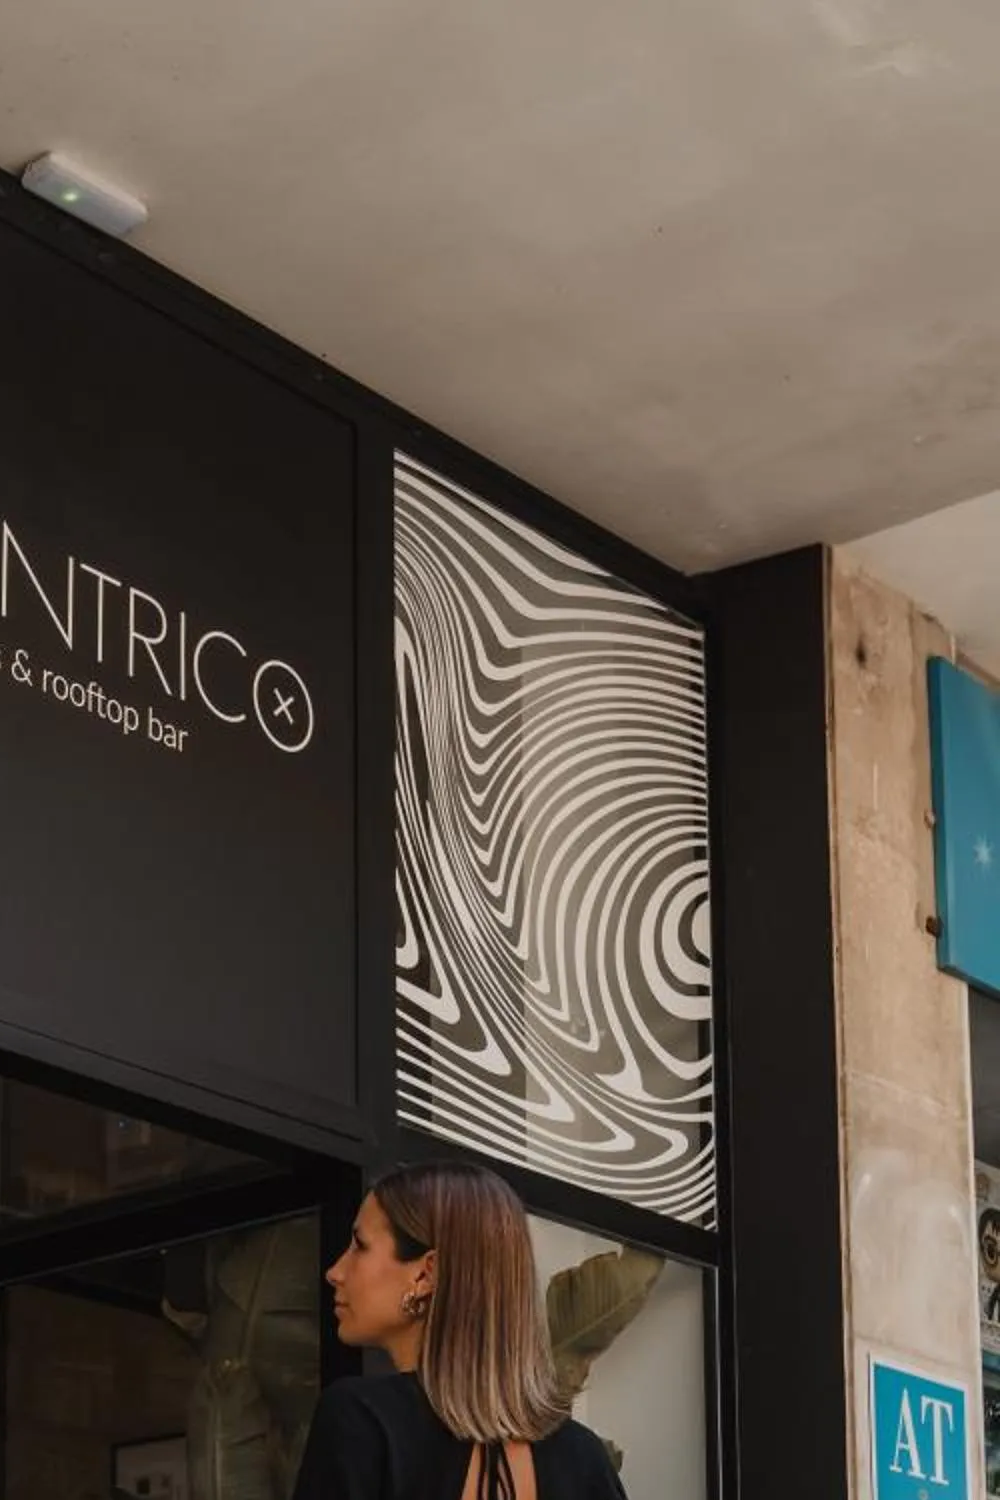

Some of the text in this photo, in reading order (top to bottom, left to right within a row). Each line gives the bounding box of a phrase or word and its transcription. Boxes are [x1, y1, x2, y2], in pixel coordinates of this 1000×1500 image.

[11, 649, 32, 687] &
[43, 668, 139, 734] rooftop
[148, 706, 188, 752] bar
[889, 1387, 953, 1486] AT
